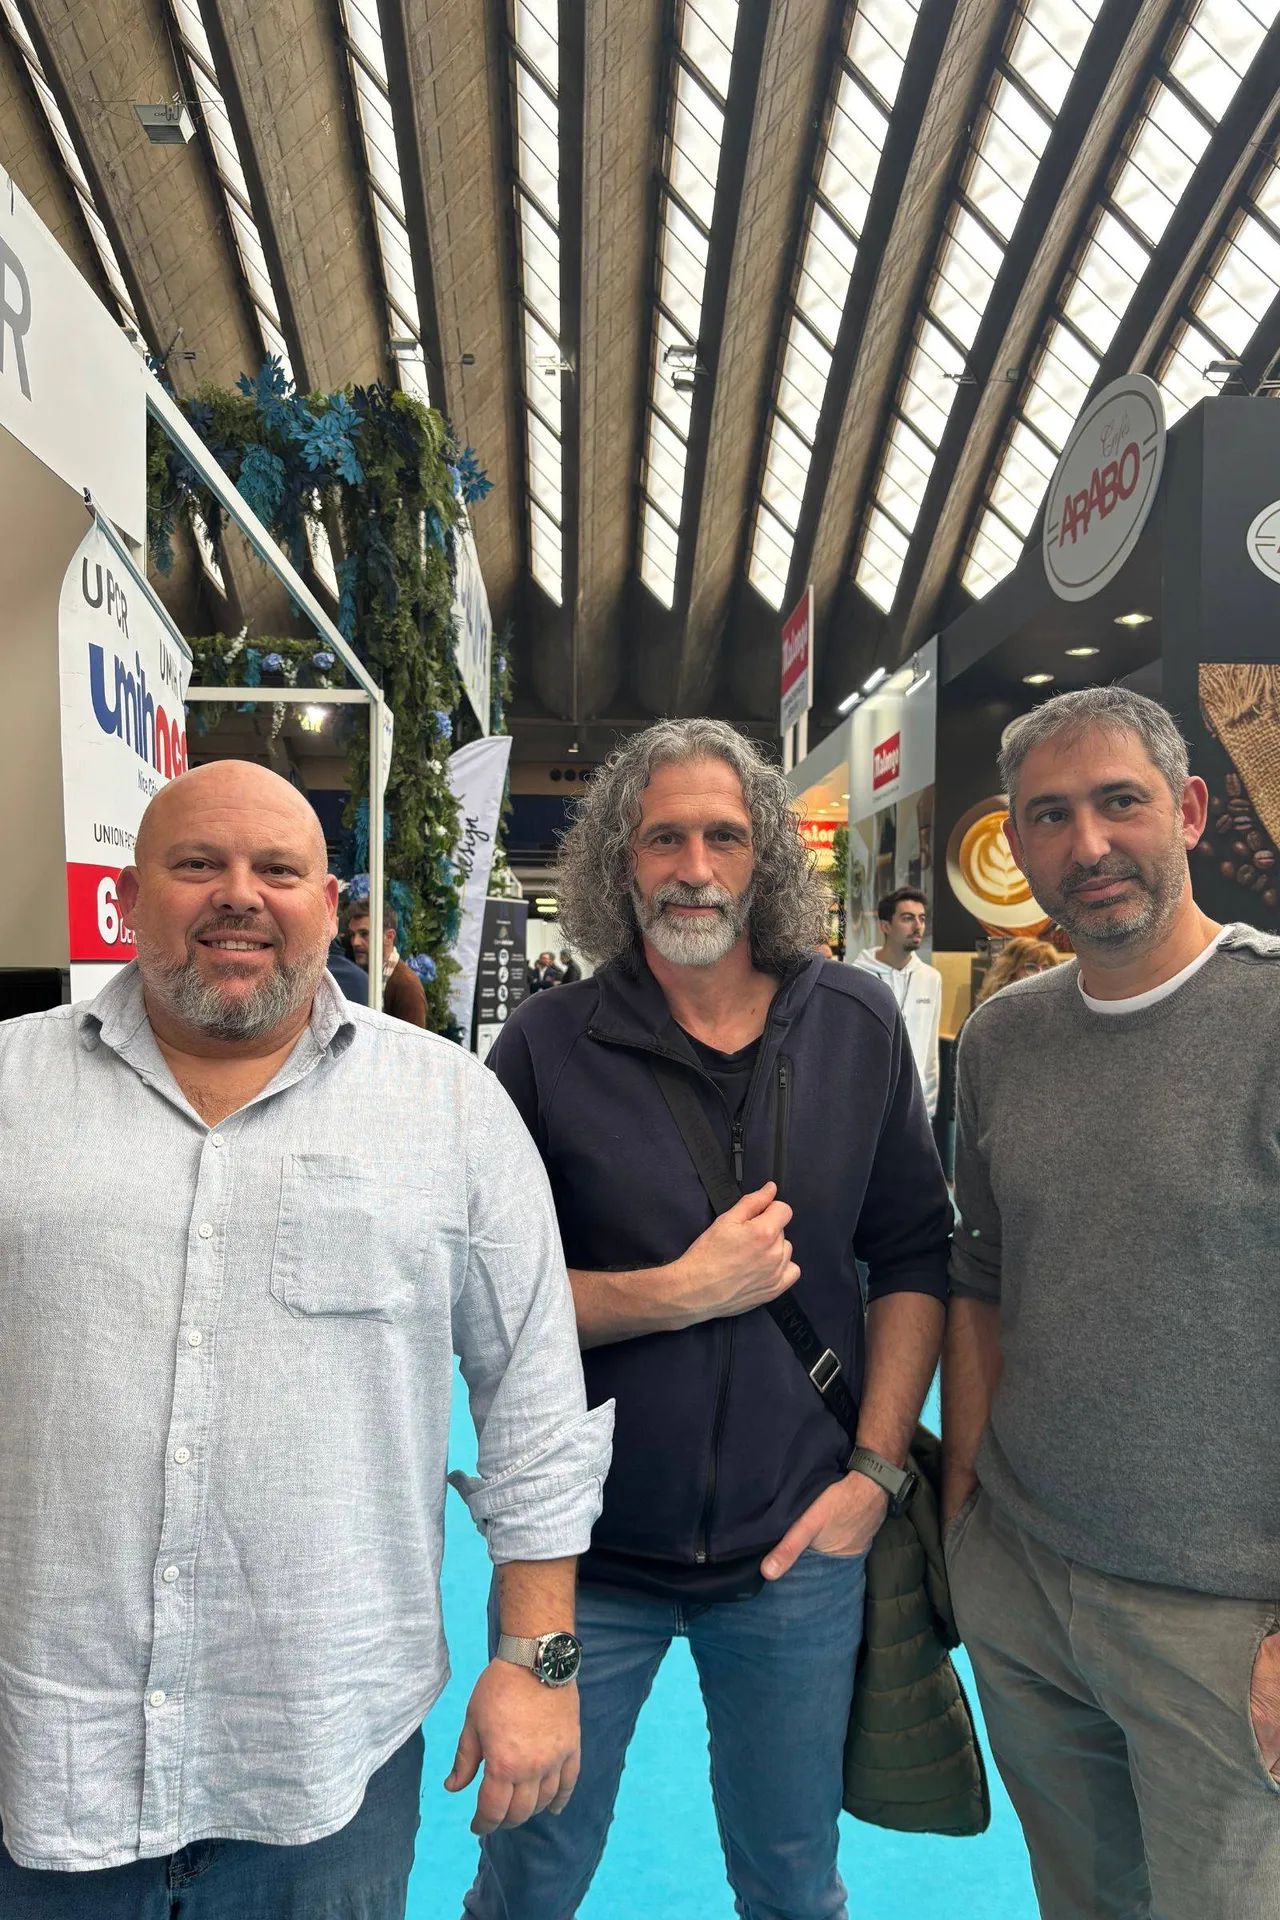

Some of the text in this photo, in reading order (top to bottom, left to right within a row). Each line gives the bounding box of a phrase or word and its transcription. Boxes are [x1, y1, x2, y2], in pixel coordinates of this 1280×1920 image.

[1059, 442, 1140, 548] ARABO
[82, 557, 129, 639] UPCR
[94, 823, 124, 848] UNION
